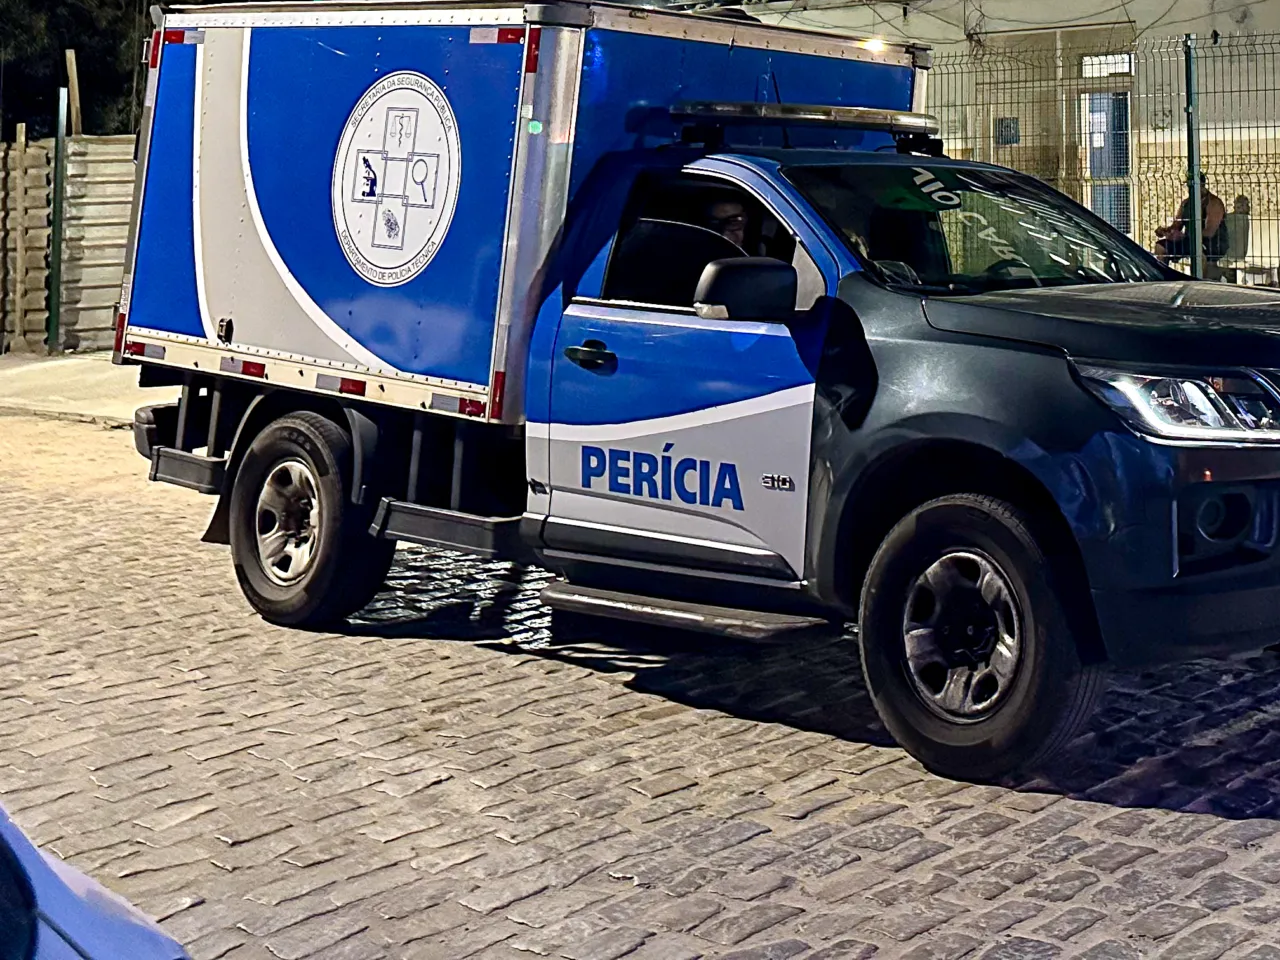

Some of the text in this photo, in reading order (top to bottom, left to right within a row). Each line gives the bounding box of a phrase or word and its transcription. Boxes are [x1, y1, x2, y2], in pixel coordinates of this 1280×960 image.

[351, 76, 453, 133] SECRETARIA DA SEGURANÇA PÚBLICA
[341, 229, 436, 280] DEPARTAMENTO DE POLÍCIA TÉCNICA
[581, 442, 745, 511] PERÍCIA
